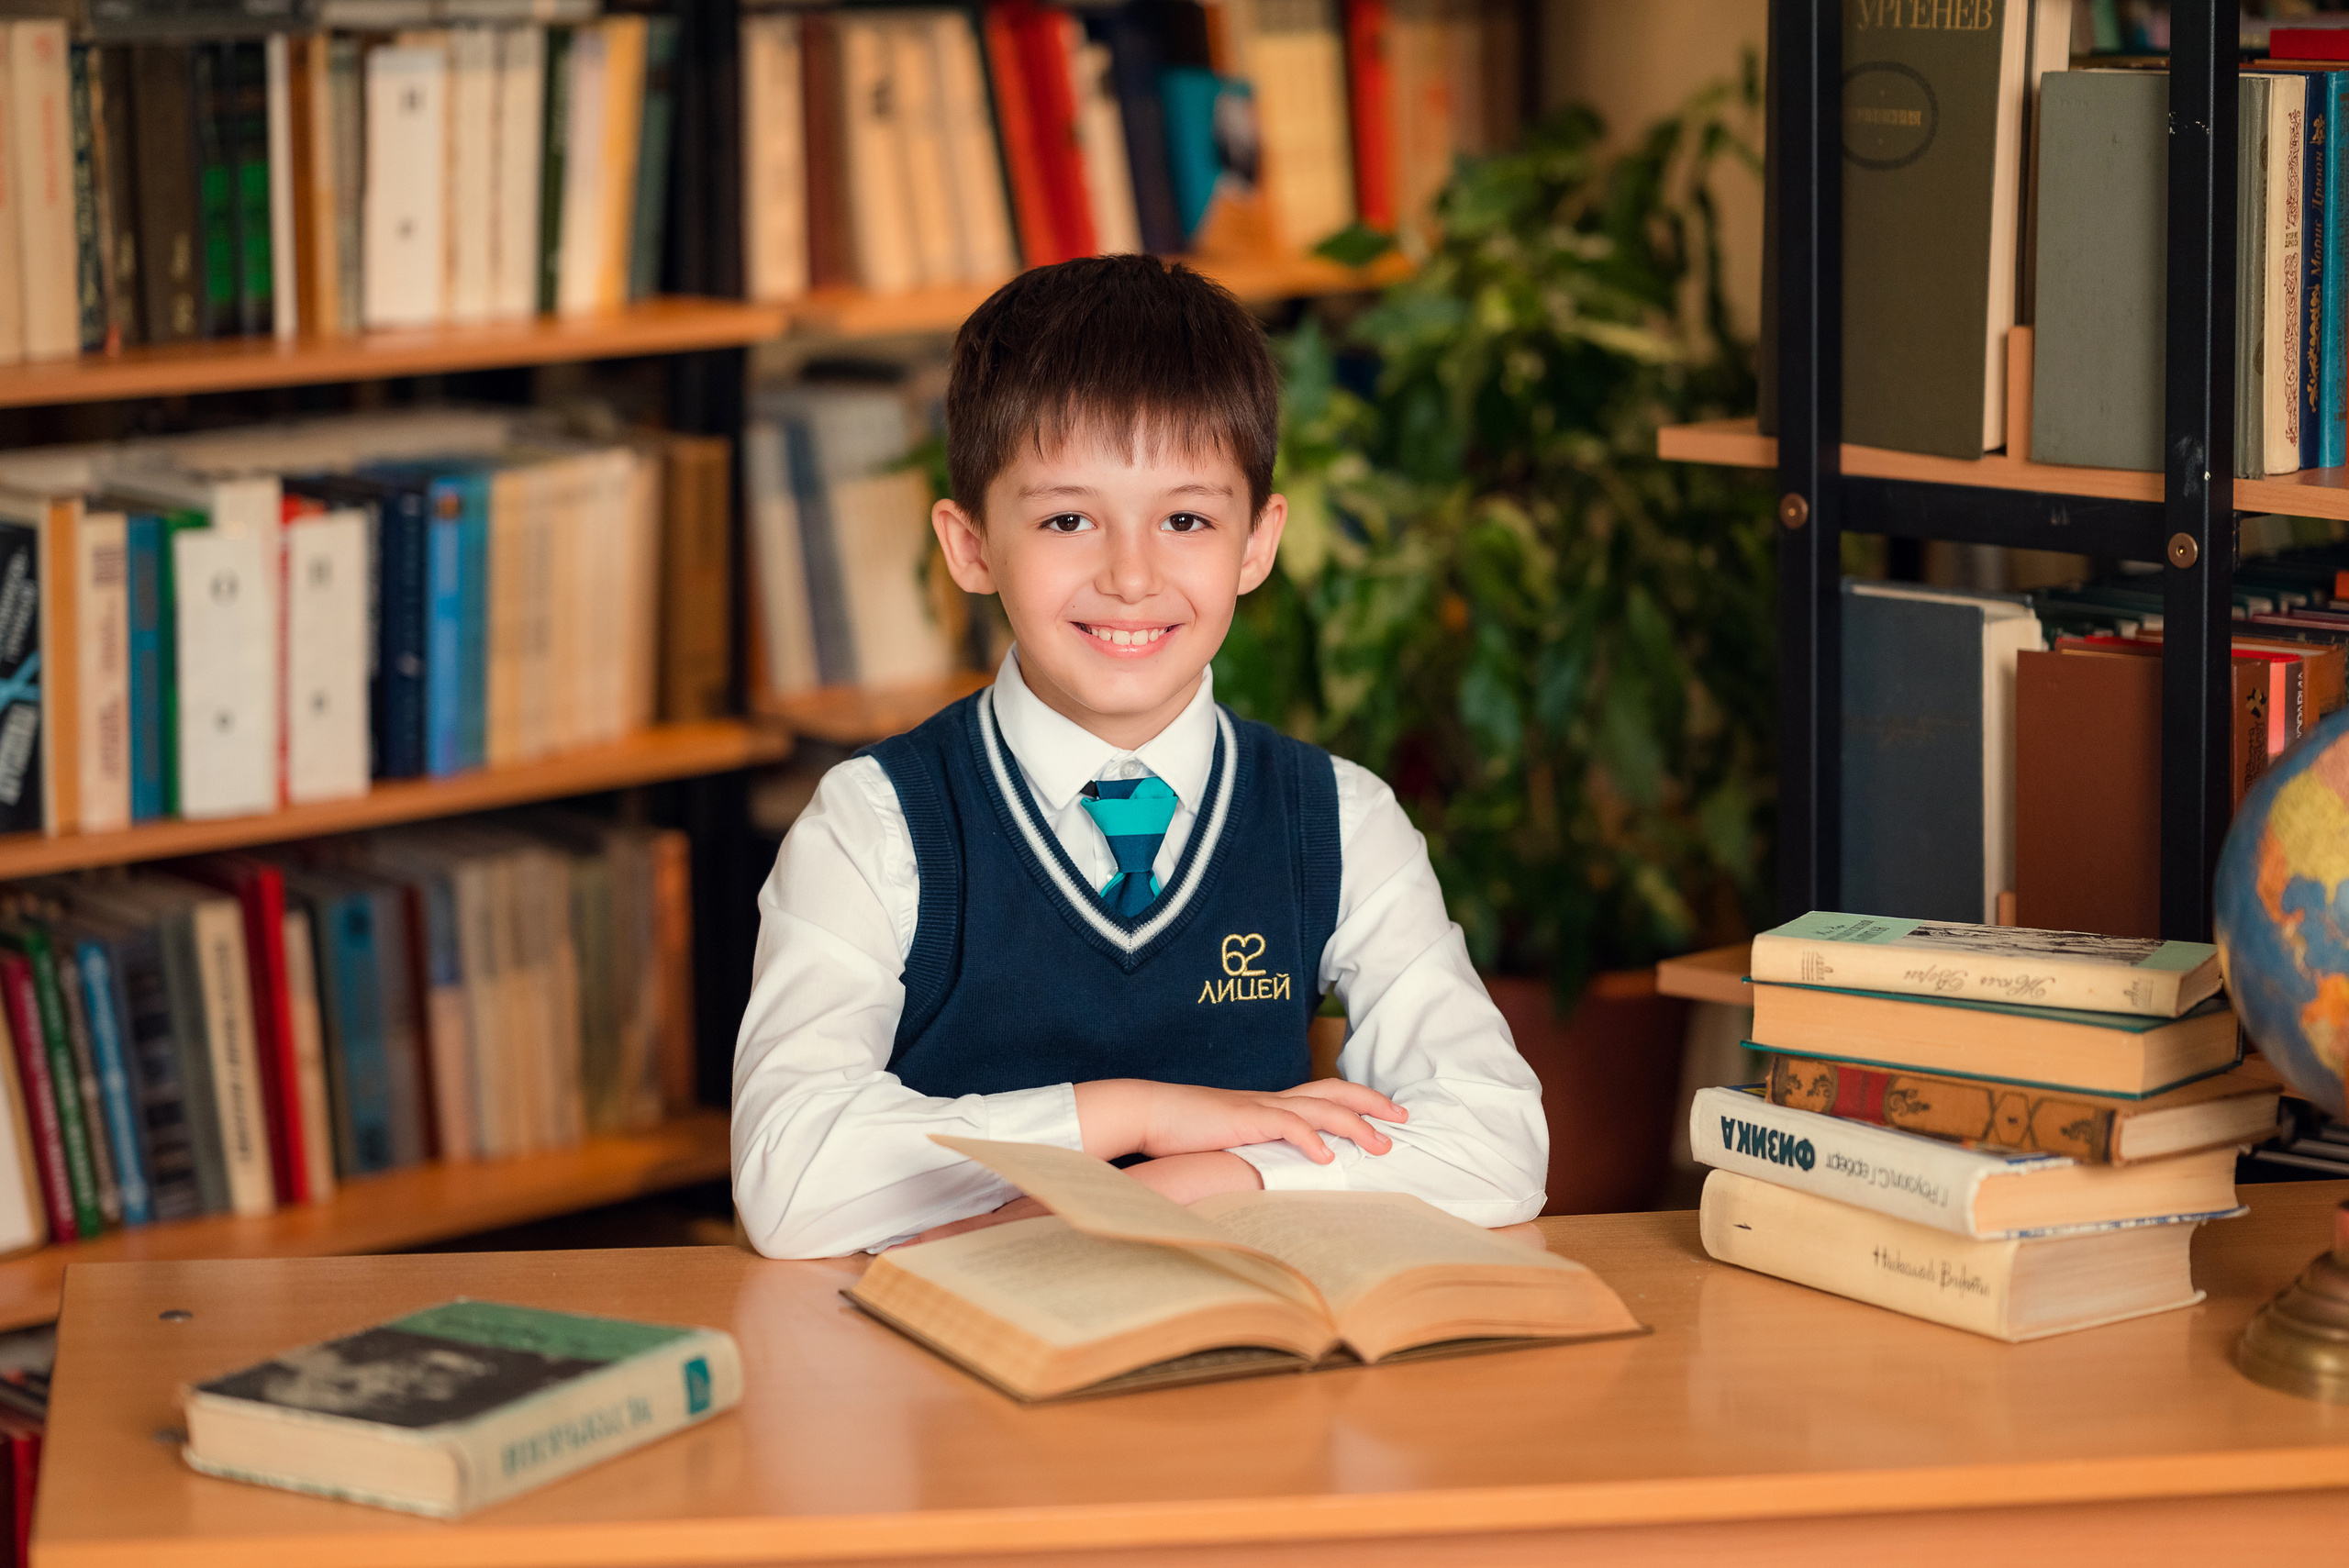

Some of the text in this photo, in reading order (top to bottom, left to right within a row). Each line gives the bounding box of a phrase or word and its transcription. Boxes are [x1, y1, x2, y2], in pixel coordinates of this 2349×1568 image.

[2310, 150, 2324, 276] Морис Дрюон
[1221, 932, 1267, 977] 62
[1197, 973, 1291, 1005] ЛИЦЕЙ
[1720, 1115, 1816, 1172] ФИЗИКА
